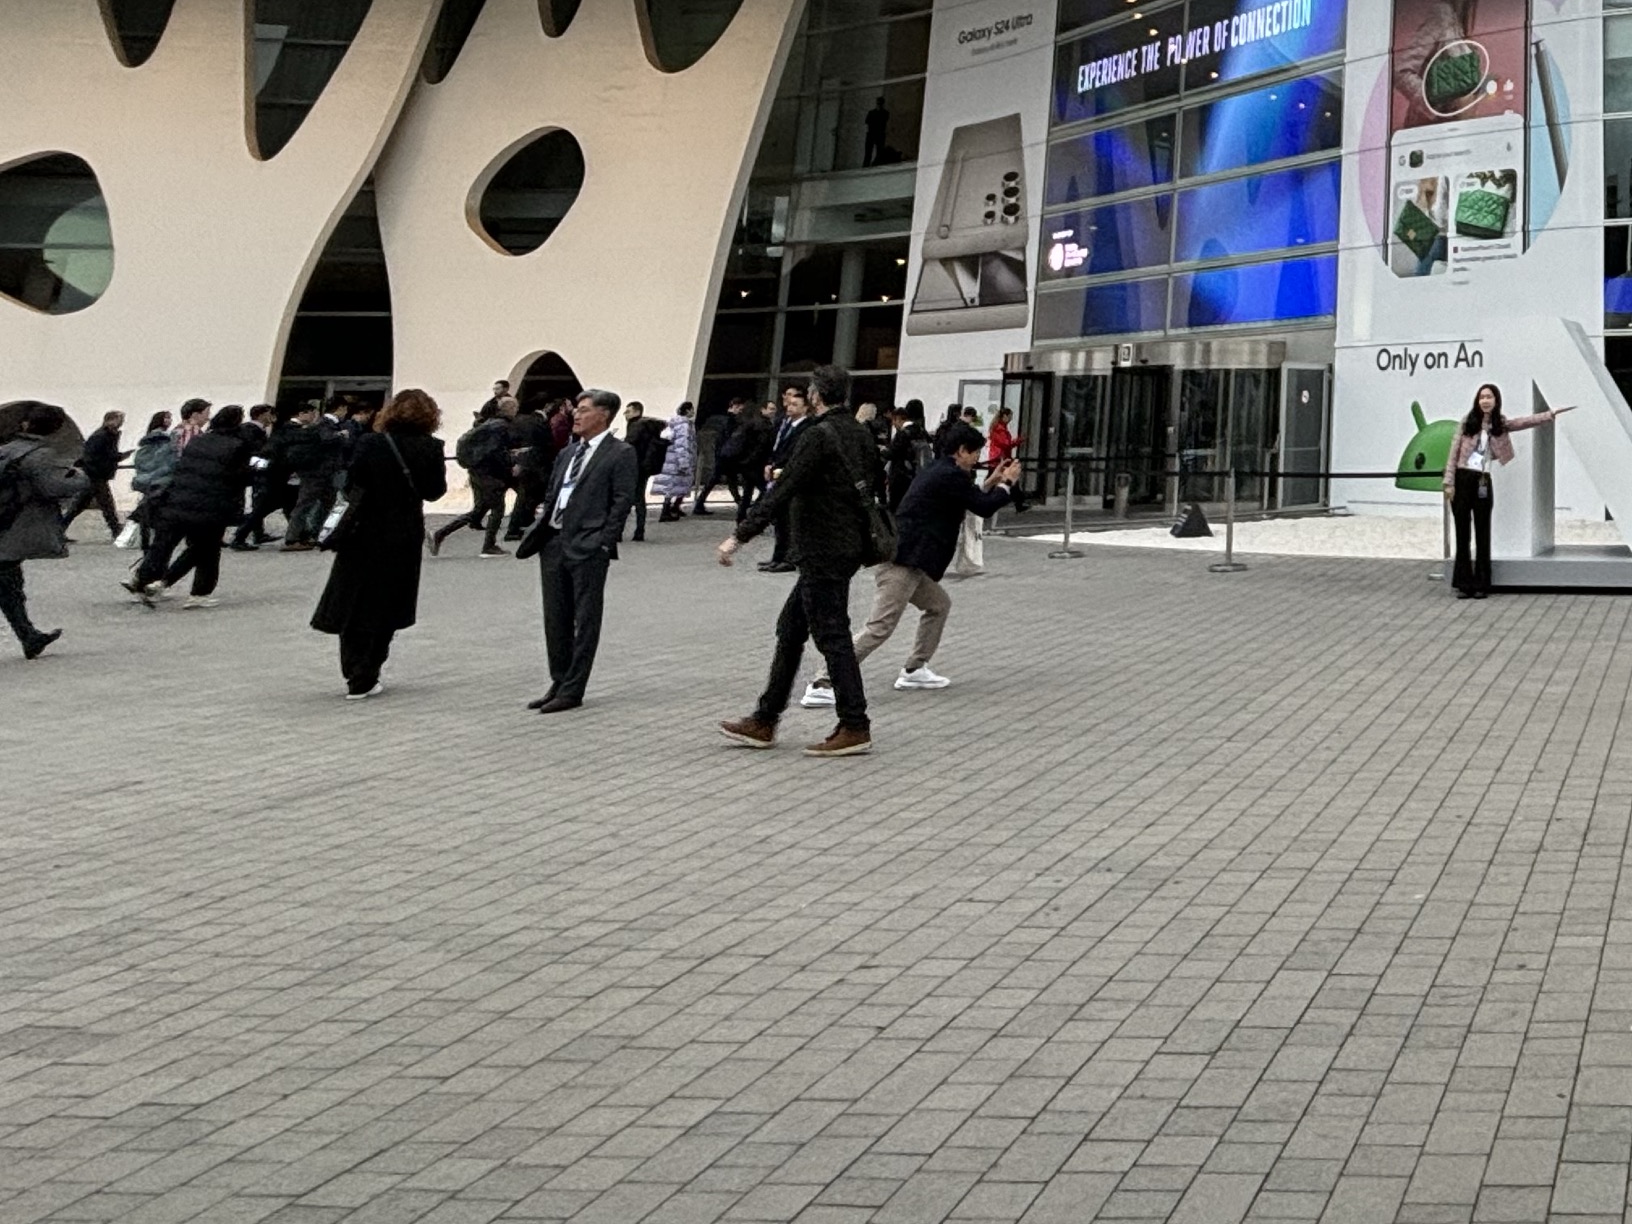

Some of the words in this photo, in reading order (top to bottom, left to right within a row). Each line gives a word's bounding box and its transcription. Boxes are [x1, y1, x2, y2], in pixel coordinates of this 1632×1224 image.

[957, 25, 993, 45] Galaxy
[1077, 48, 1138, 94] EXPERIENCE
[1141, 41, 1161, 74] THE
[1214, 18, 1230, 53] OF
[1376, 347, 1420, 377] Only
[1424, 351, 1449, 370] on
